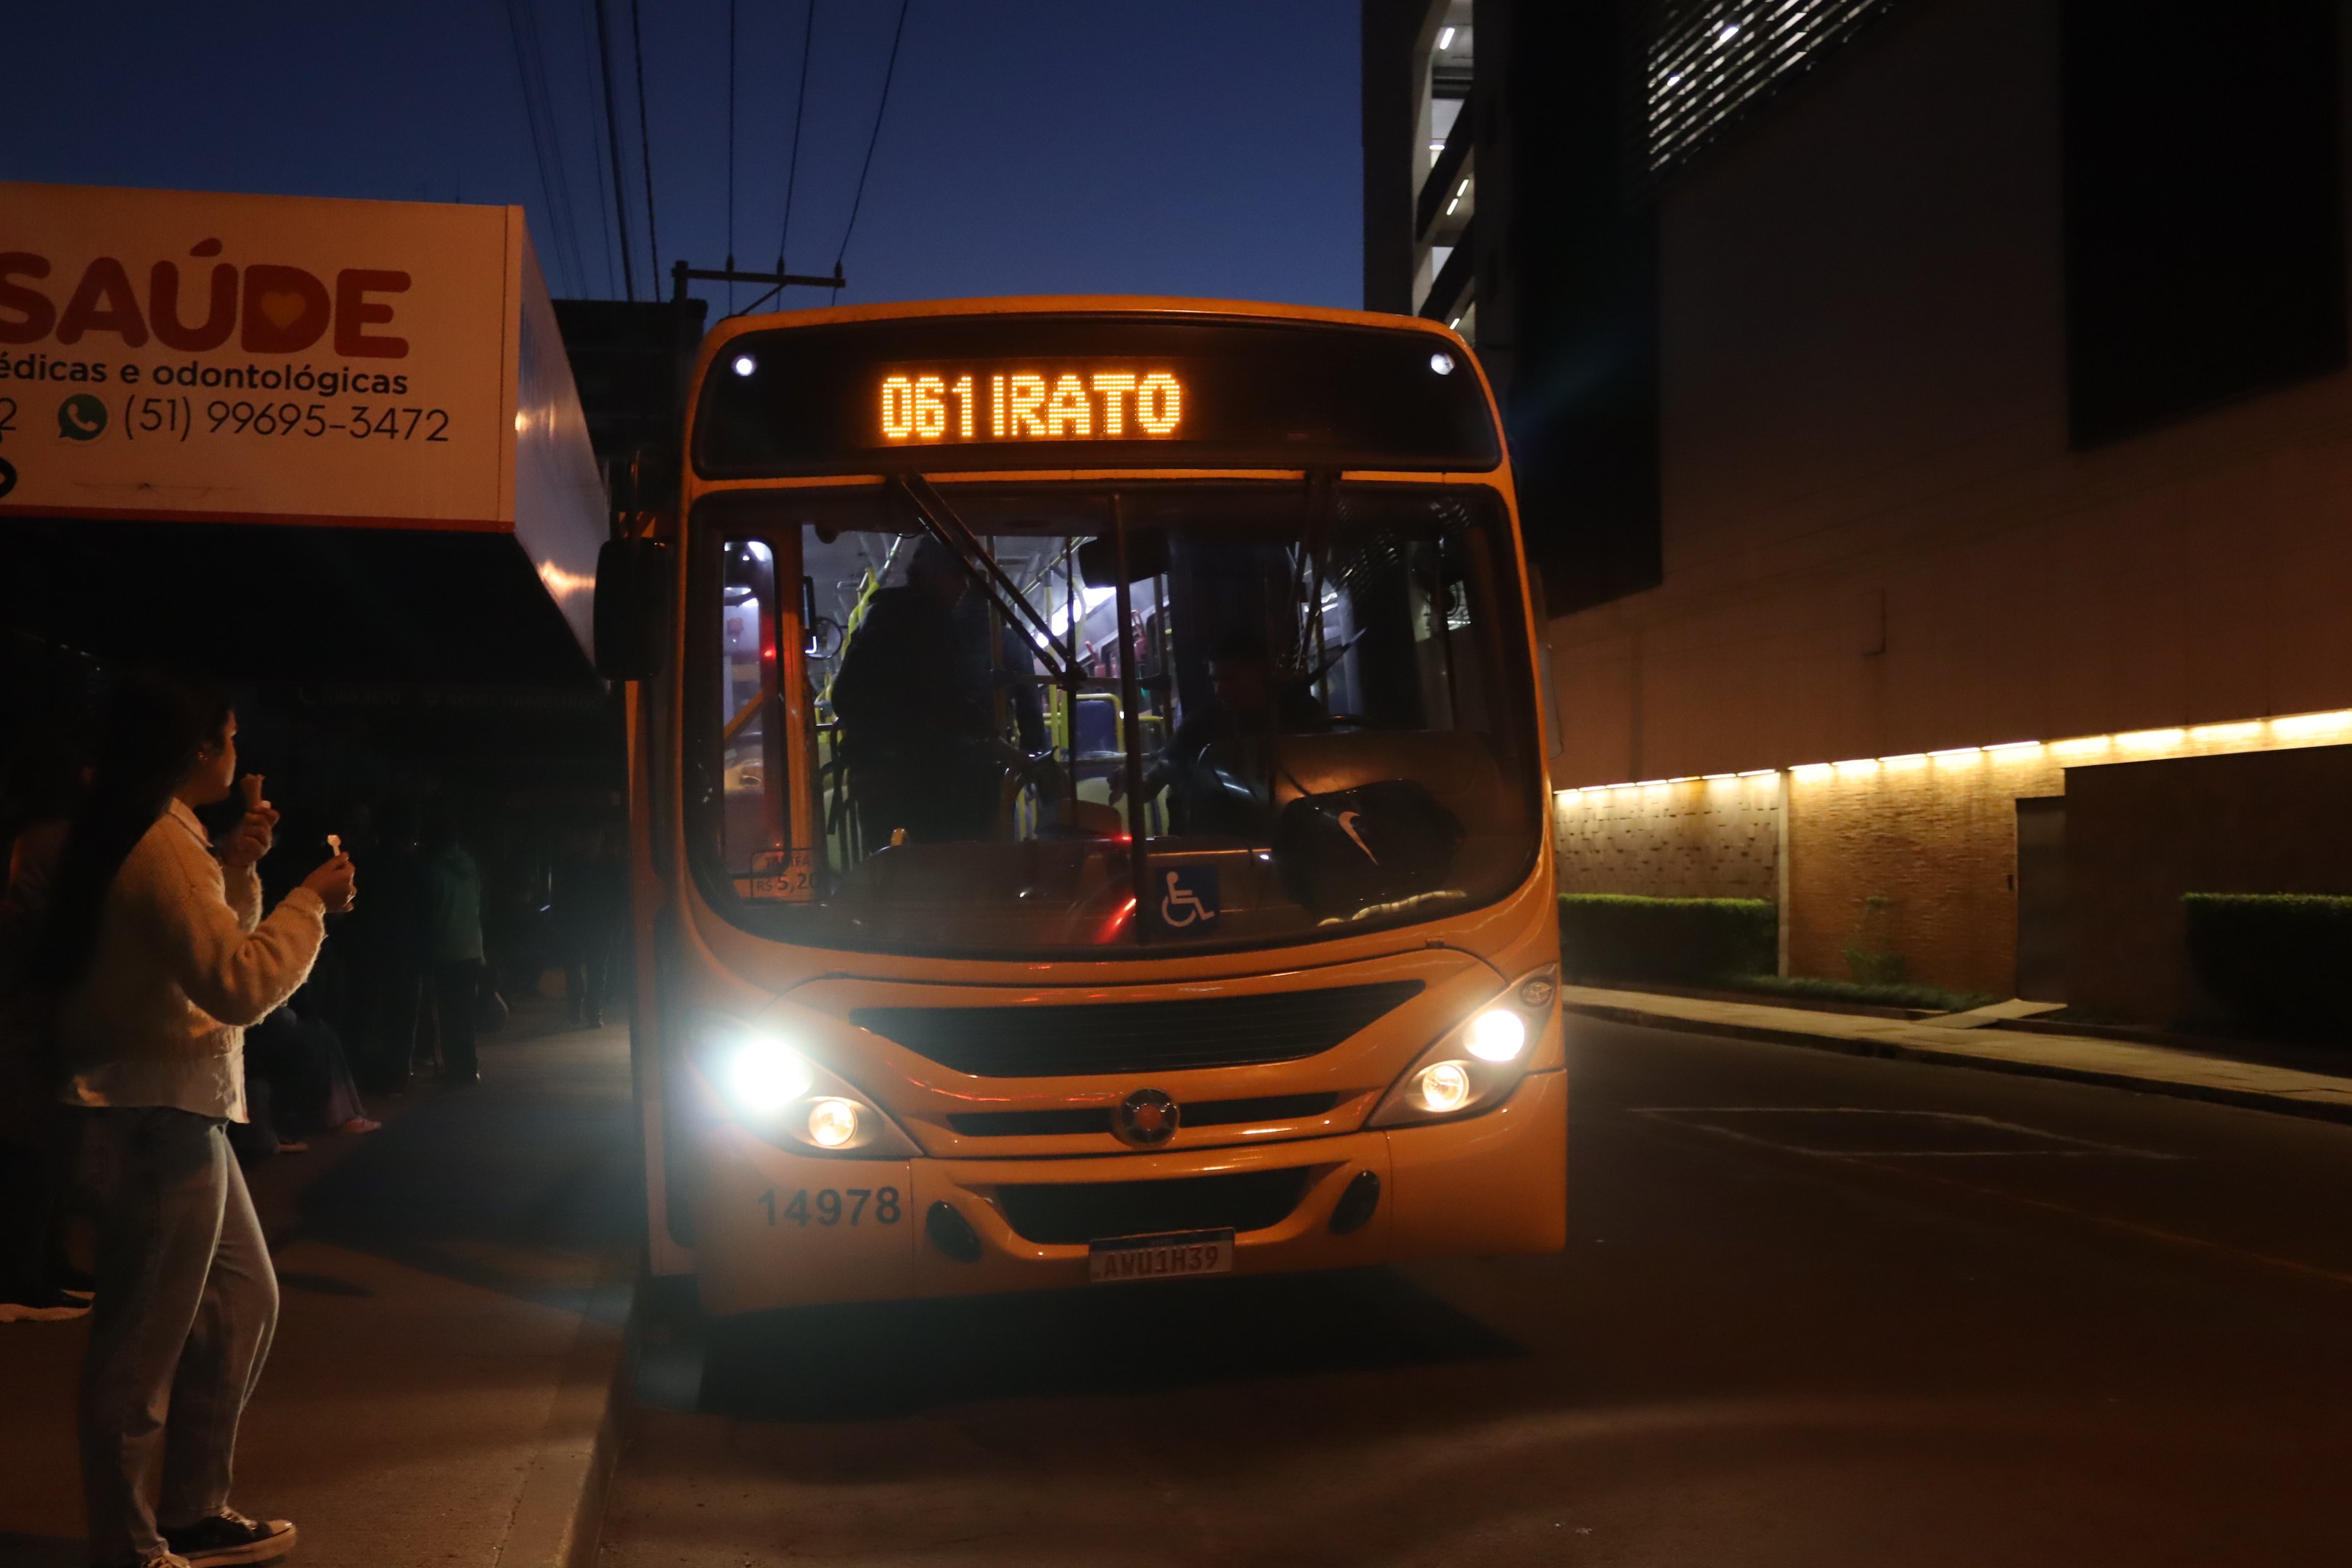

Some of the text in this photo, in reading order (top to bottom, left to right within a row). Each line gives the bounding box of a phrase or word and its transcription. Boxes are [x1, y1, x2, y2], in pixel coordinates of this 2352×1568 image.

[0, 238, 412, 359] SAÚDE
[121, 364, 140, 384] e
[152, 361, 408, 396] odontológicas
[125, 394, 190, 442] (51)
[208, 400, 449, 441] 99695-3472
[882, 374, 1181, 437] 061 IRATO
[764, 855, 809, 867] TAIFA
[758, 1186, 902, 1227] 14978
